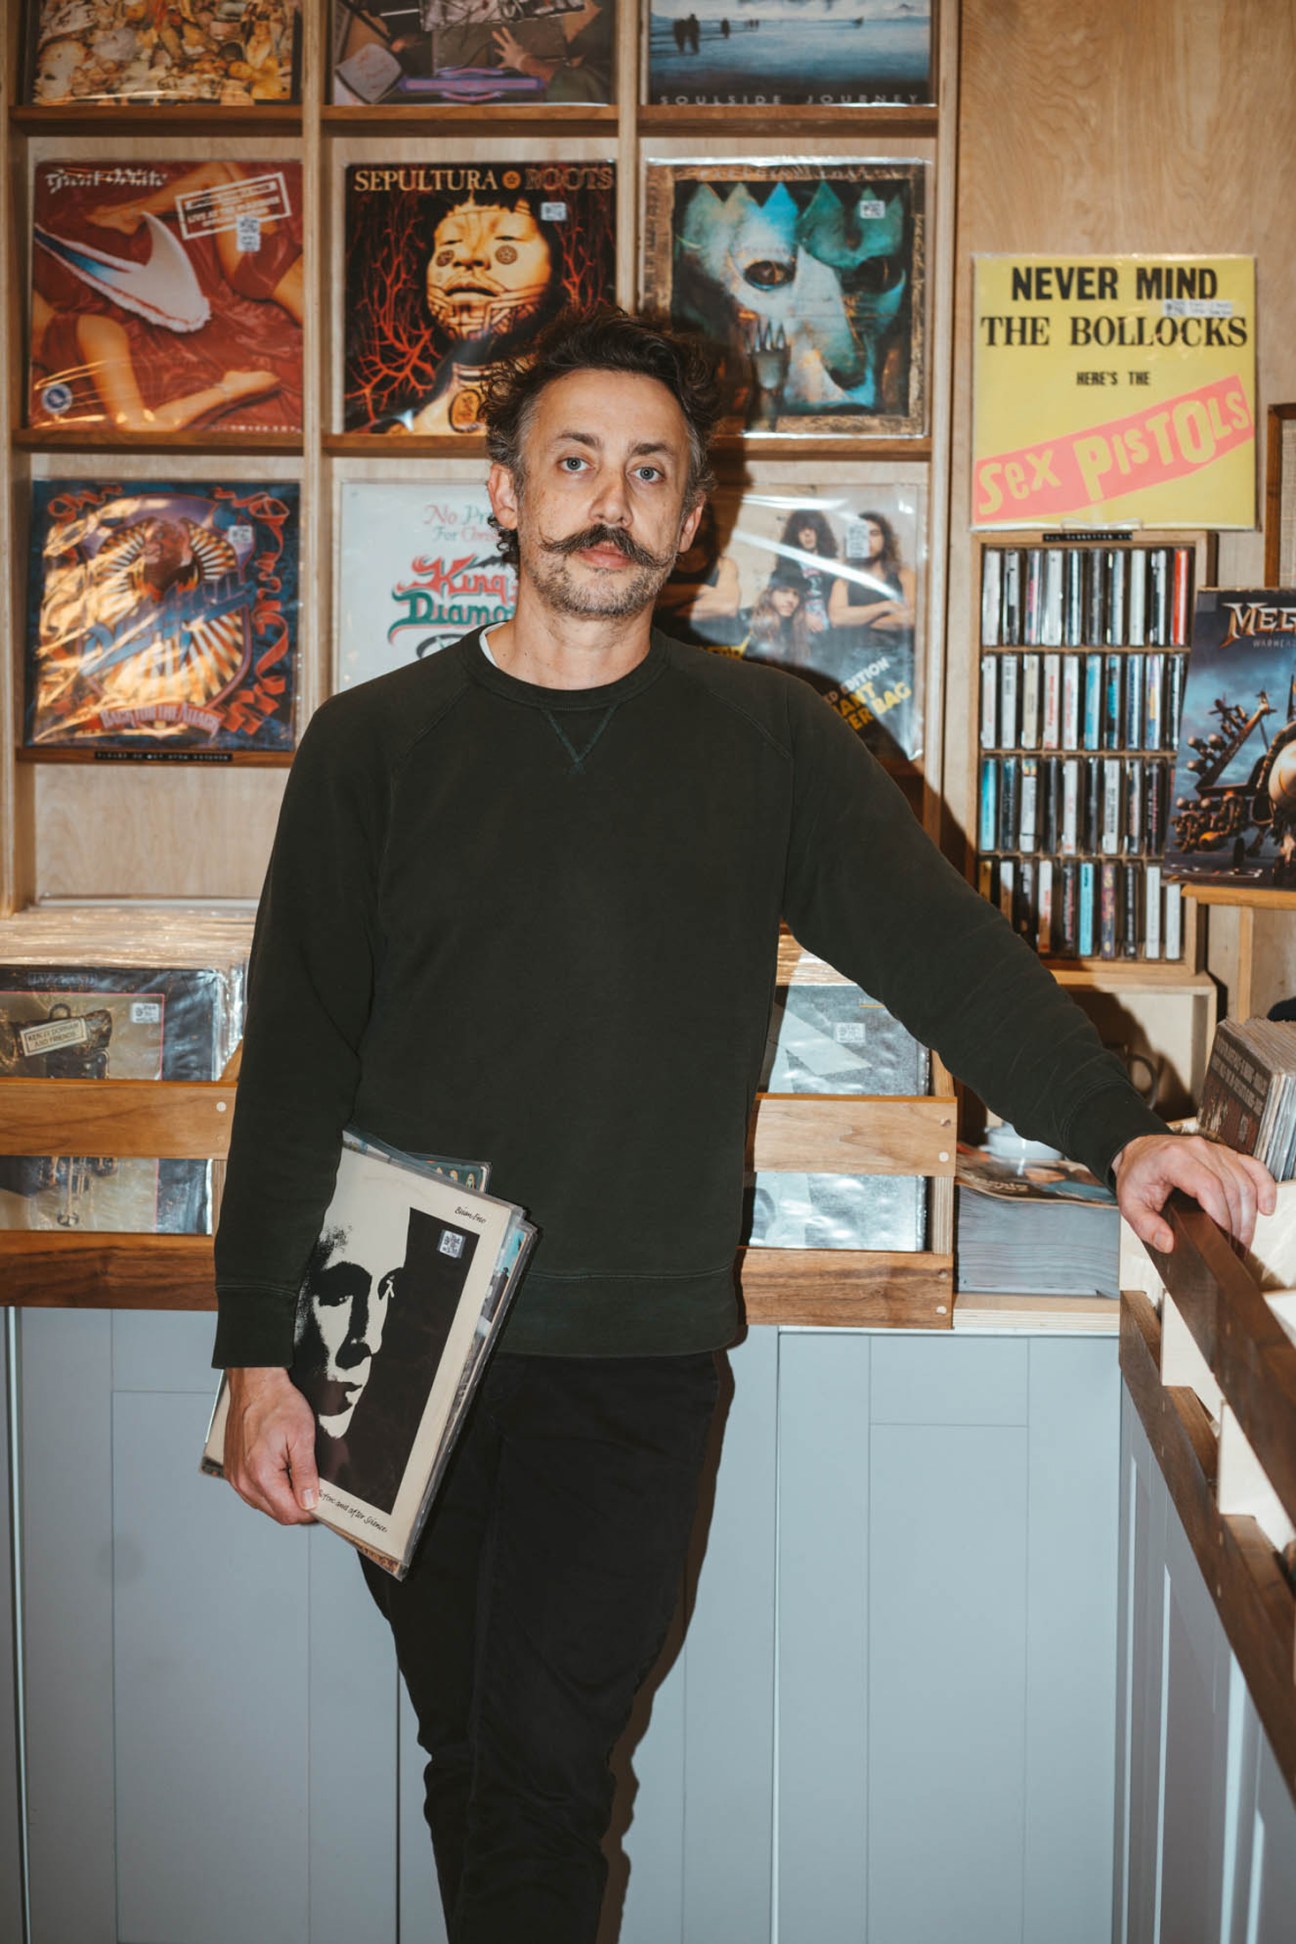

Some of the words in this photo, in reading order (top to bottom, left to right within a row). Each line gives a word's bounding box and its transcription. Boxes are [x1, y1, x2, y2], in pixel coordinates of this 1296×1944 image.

[659, 95, 782, 105] SOULSIDE
[806, 94, 918, 104] JOURNEY
[353, 169, 499, 191] SEPULTURA
[525, 168, 614, 191] ROOTS
[1011, 266, 1119, 301] NEVER
[1135, 266, 1218, 301] MIND
[980, 315, 1051, 347] THE
[1069, 315, 1249, 347] BOLLOCKS
[1076, 371, 1119, 386] HERE'S
[1128, 371, 1151, 386] THE
[424, 504, 458, 526] No
[396, 553, 508, 605] King
[1252, 639, 1296, 649] WARHEA
[871, 681, 913, 714] BAG
